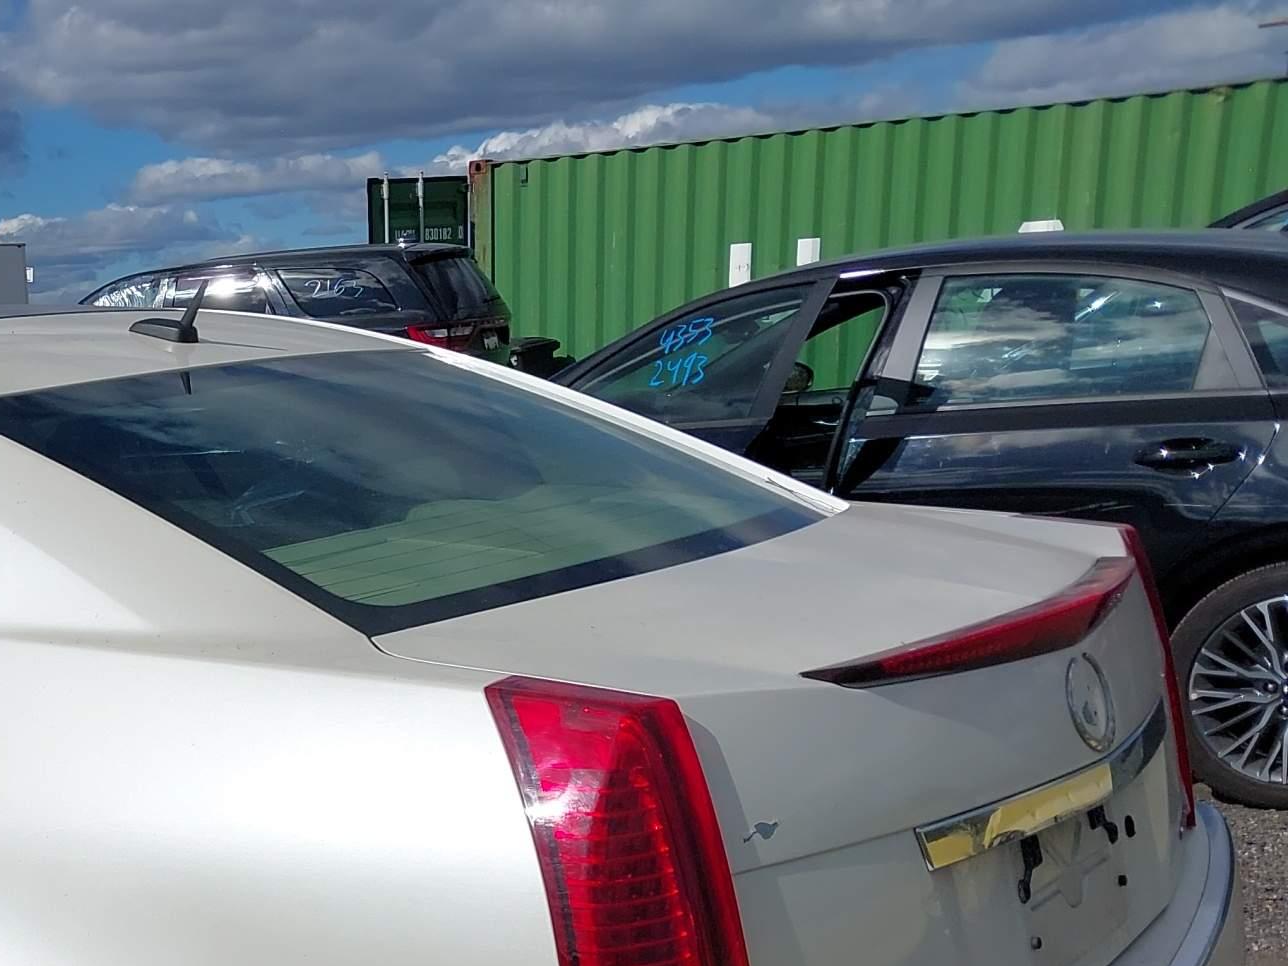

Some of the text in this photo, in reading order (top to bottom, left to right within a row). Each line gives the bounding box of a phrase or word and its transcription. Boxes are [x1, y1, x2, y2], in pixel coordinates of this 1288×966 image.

[425, 227, 453, 241] 830182
[304, 278, 364, 298] 2163
[659, 317, 715, 354] 4353
[648, 351, 707, 386] 2493
